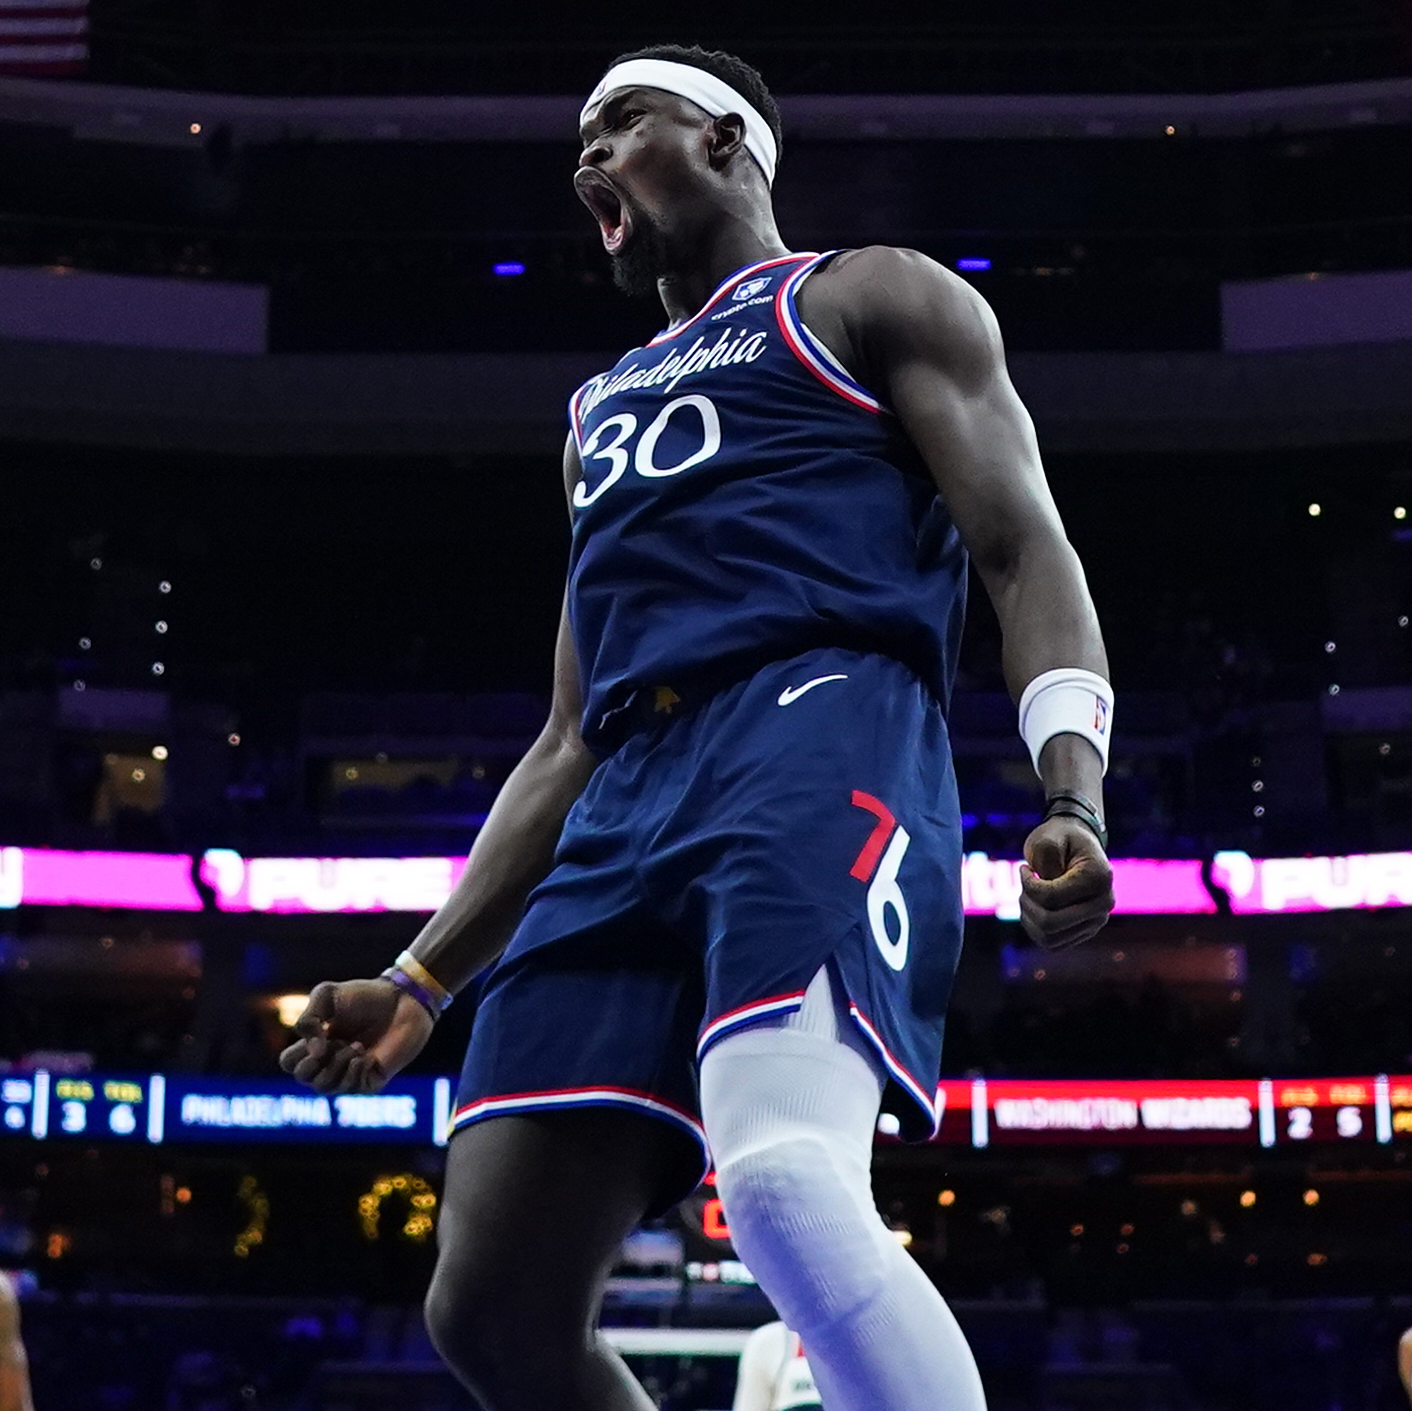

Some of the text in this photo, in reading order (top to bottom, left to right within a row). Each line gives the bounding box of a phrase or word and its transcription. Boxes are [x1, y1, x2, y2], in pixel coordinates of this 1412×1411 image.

[711, 294, 774, 322] crypto.com
[574, 393, 722, 509] 30
[246, 854, 455, 911] PURE
[849, 789, 910, 972] 76
[60, 1101, 136, 1134] 3 6
[1287, 1107, 1313, 1139] 2
